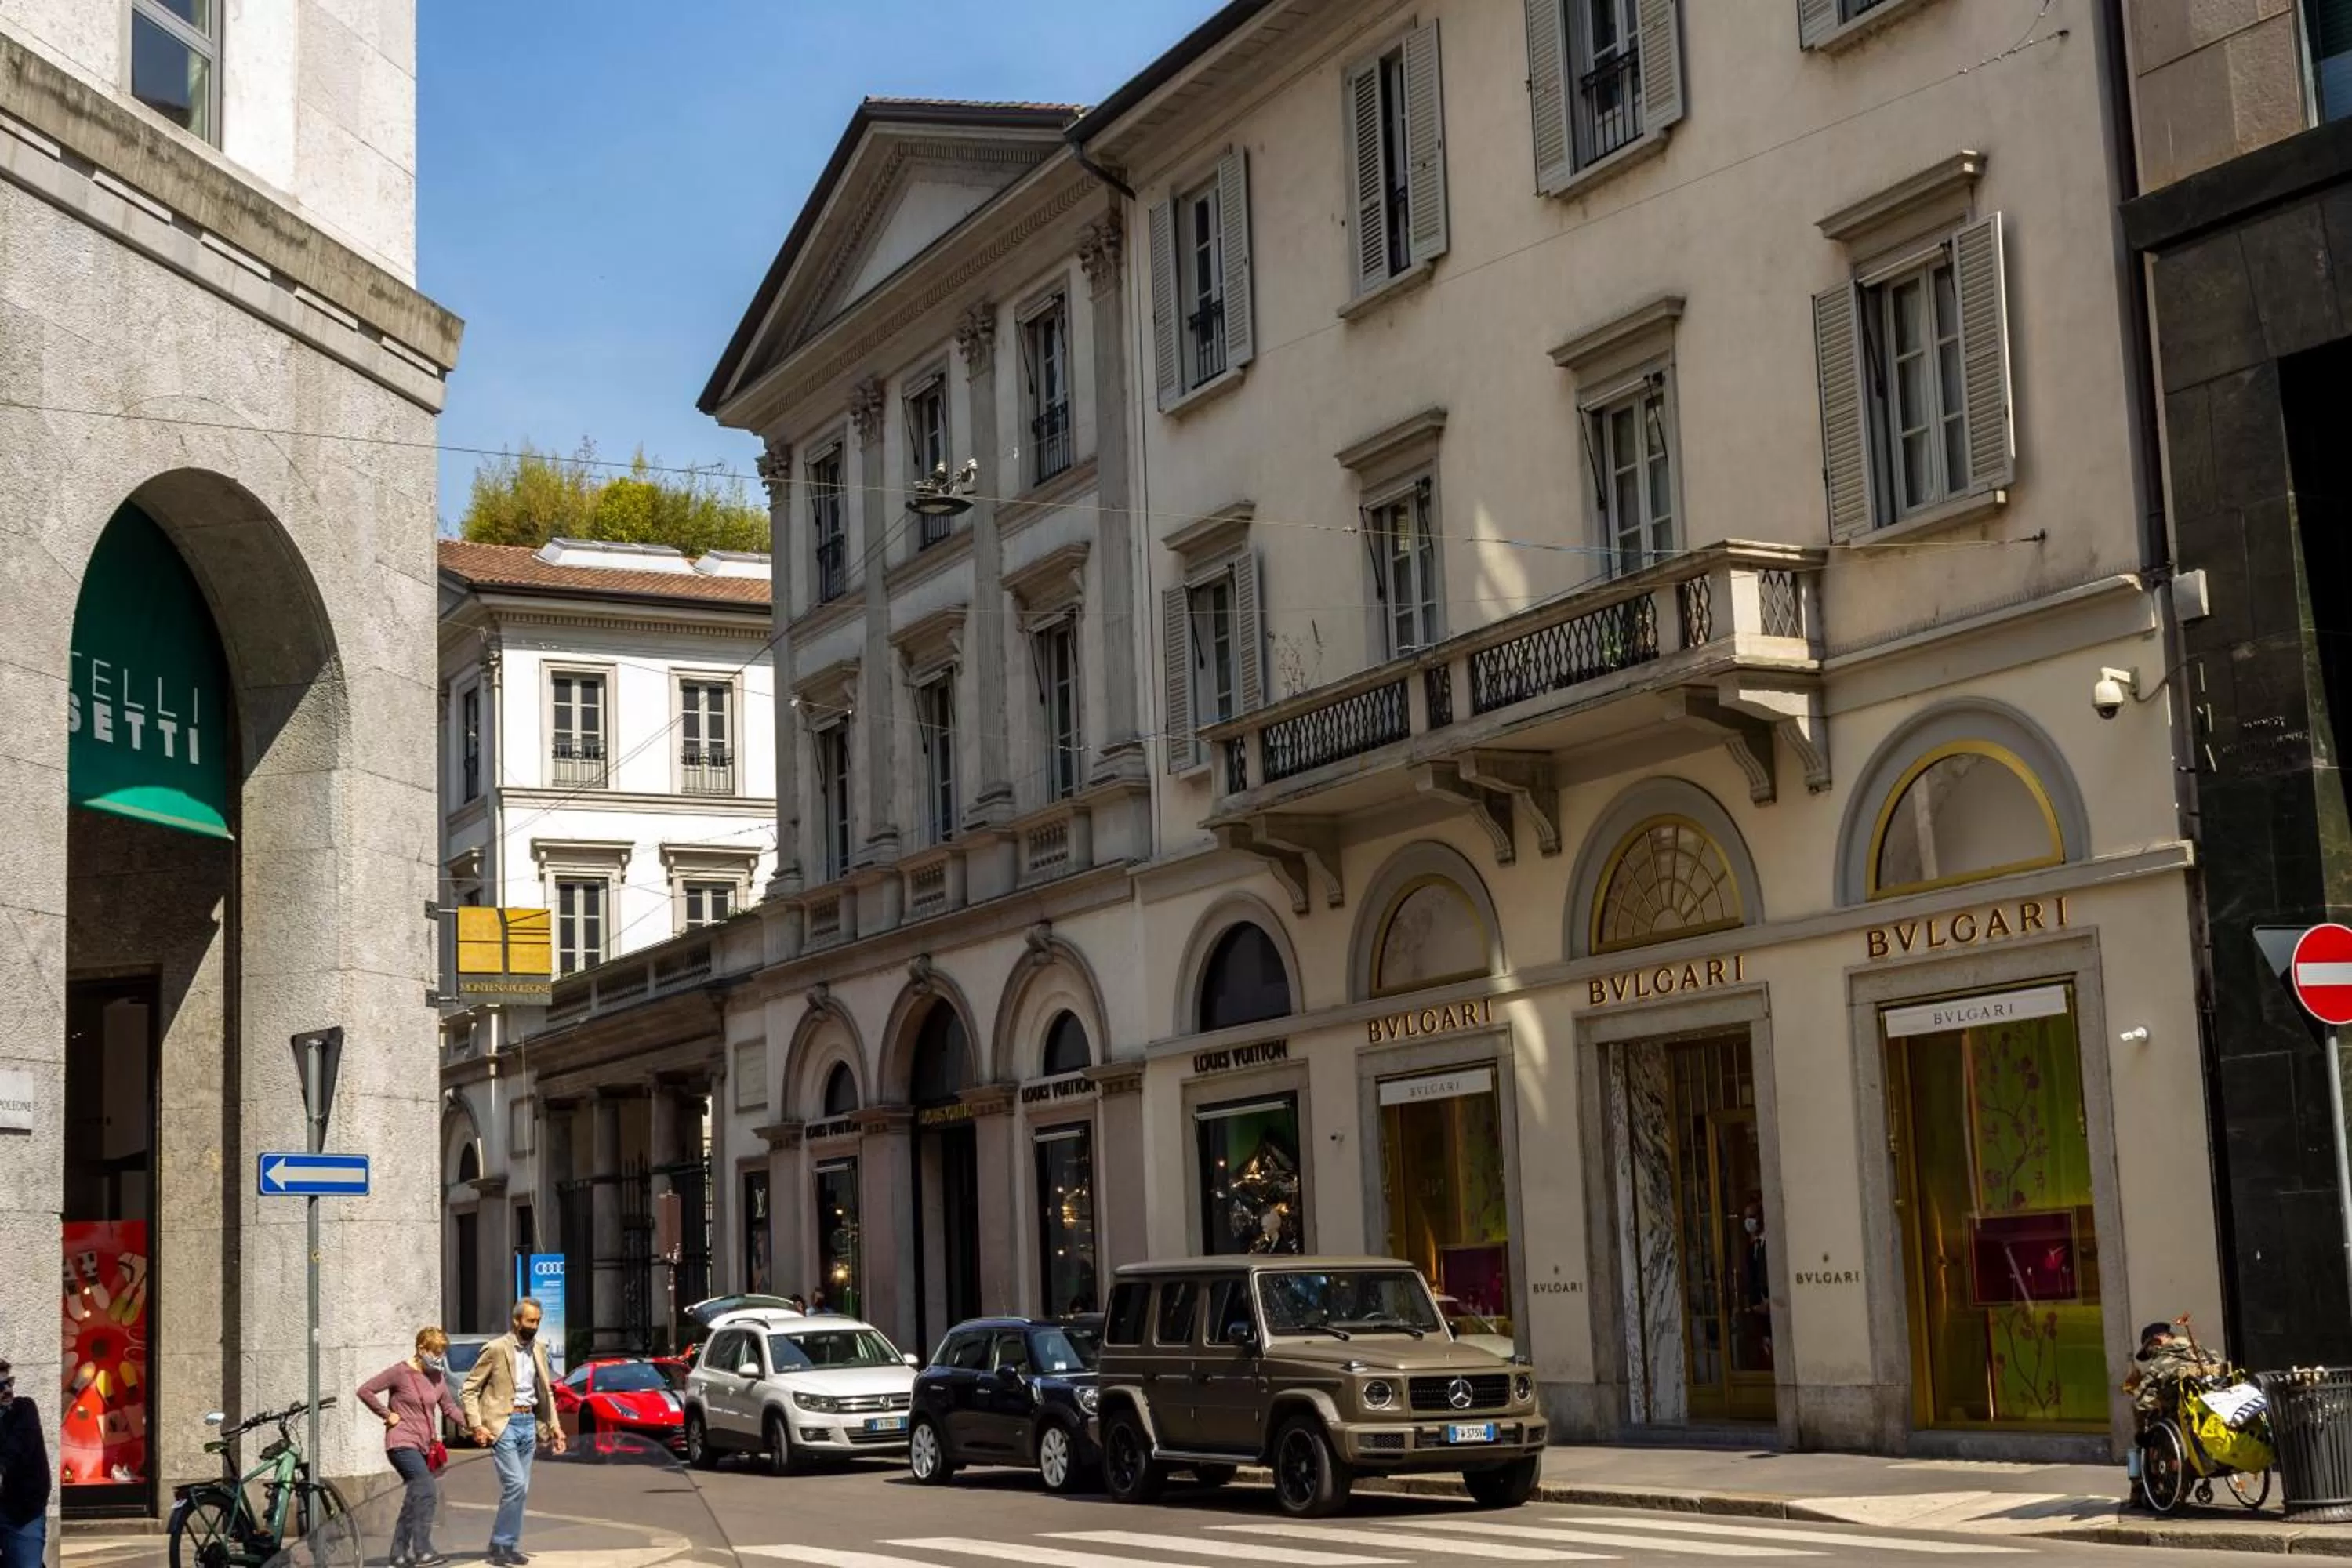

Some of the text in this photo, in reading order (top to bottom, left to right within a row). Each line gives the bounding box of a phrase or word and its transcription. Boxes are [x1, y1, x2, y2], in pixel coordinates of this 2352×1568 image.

[1867, 896, 2067, 959] BVLGARI
[1588, 953, 1744, 1006] BVLGARI
[1367, 997, 1493, 1043] BVLGARI
[1933, 1003, 2014, 1025] BVLGARI
[1193, 1037, 1288, 1073] LOUIS VUITTON
[1022, 1077, 1097, 1103] LOUIS VUITTON
[1409, 1081, 1460, 1097] BVLGARI
[1532, 1280, 1583, 1295] BVLGARI
[1795, 1270, 1860, 1284] BVLGARI
